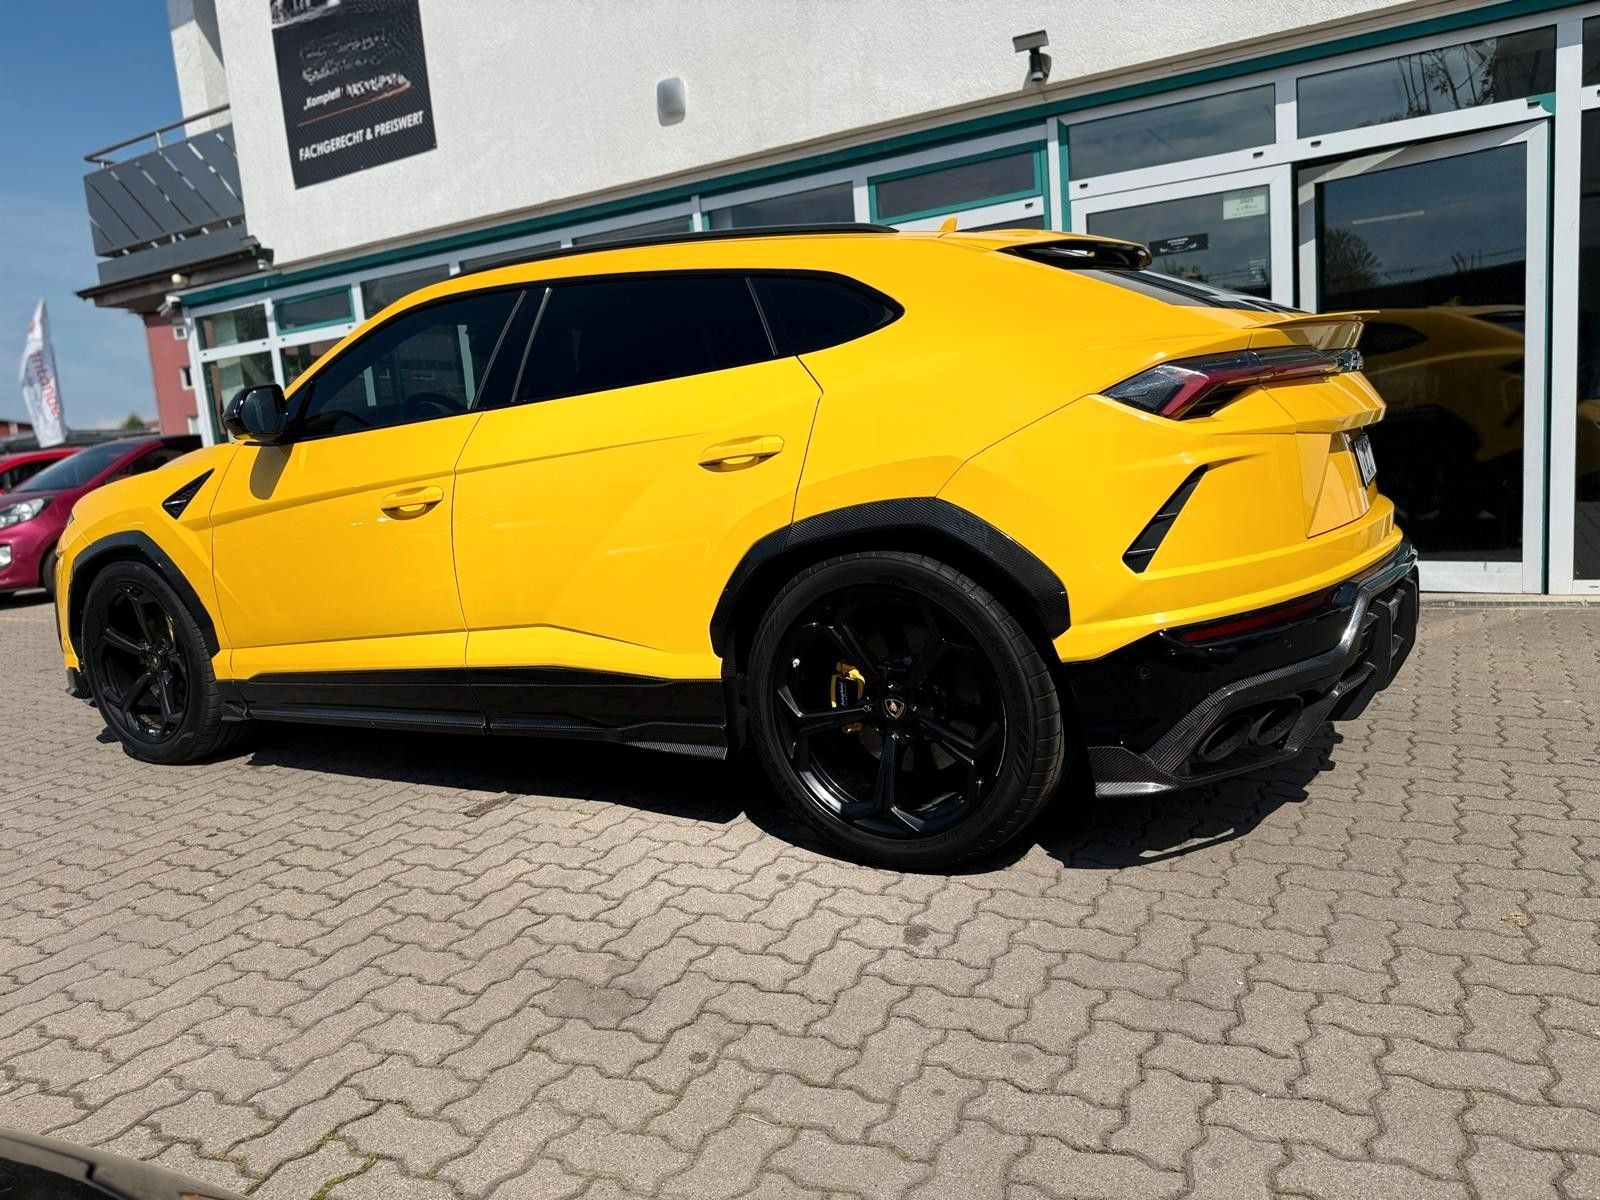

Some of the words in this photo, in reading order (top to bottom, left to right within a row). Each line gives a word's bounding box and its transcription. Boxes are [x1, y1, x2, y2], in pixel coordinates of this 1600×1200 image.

[299, 129, 364, 161] FACHGERECHT
[365, 127, 373, 141] &
[374, 110, 424, 138] PREISWERT
